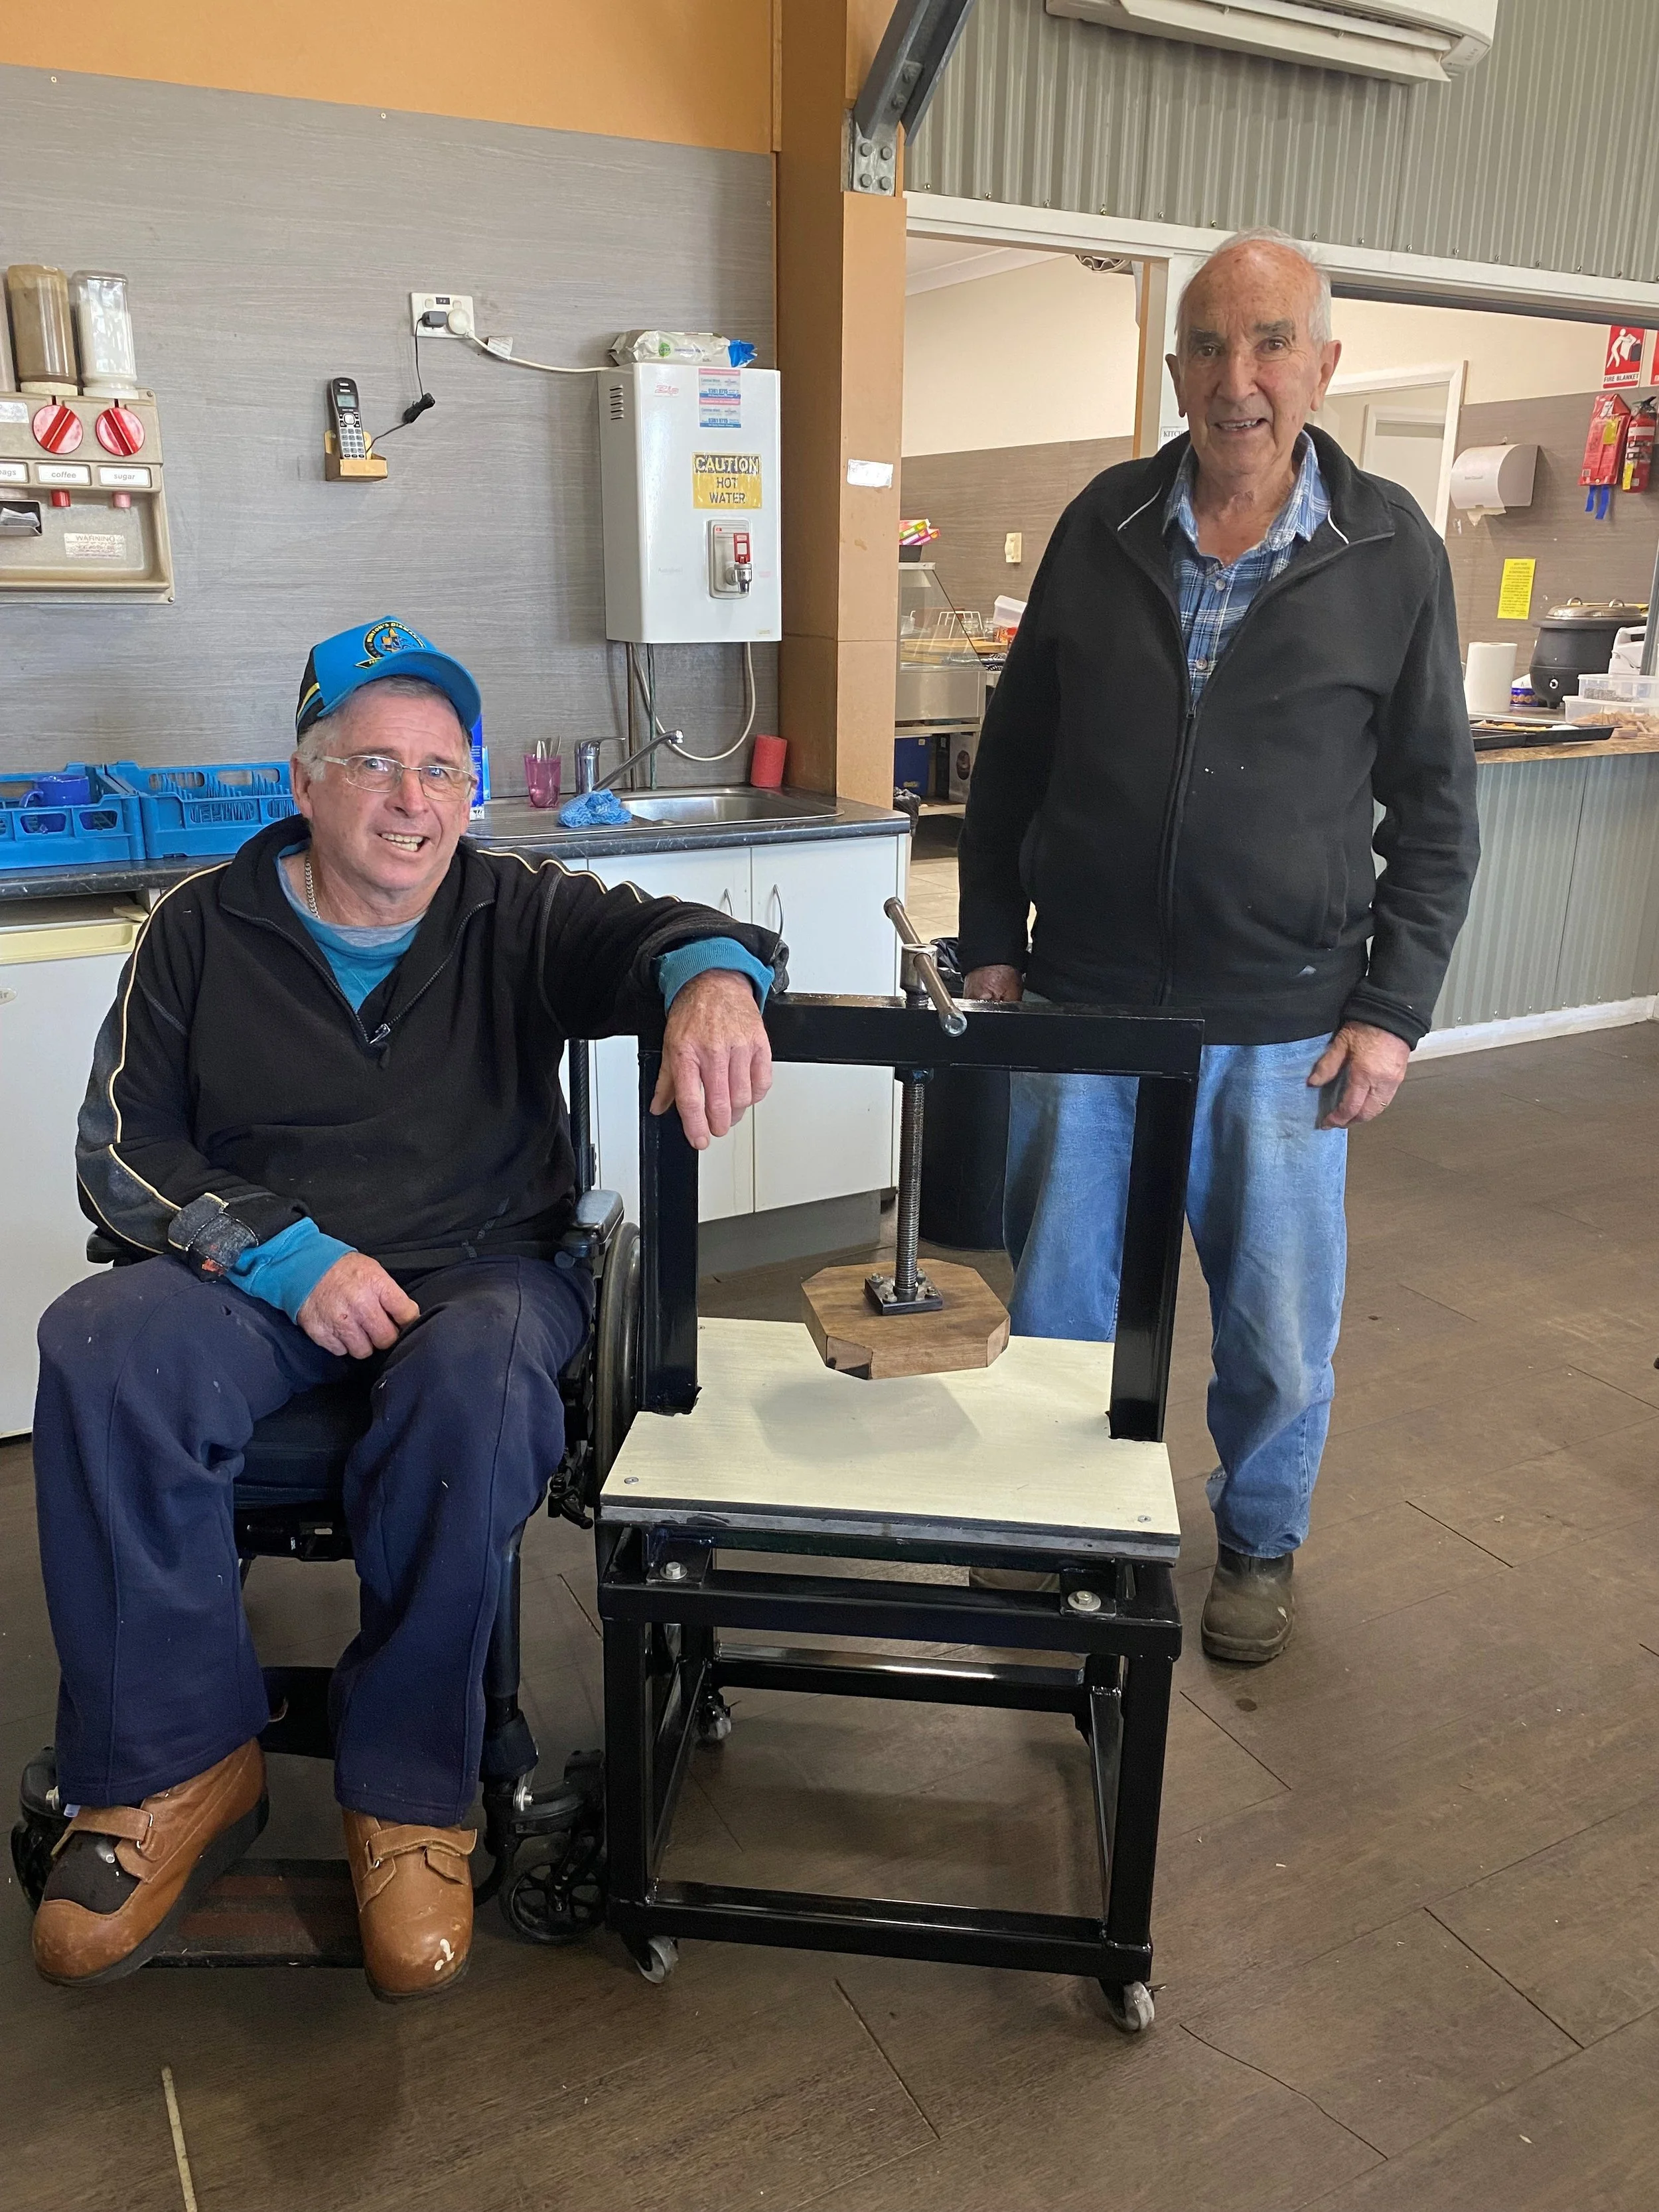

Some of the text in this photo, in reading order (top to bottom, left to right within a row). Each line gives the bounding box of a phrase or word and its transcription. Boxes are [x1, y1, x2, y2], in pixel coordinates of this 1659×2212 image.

[1616, 373, 1639, 382] BLANKET
[695, 457, 759, 473] CAUTION
[717, 477, 738, 488] HOT
[709, 492, 746, 504] WATER
